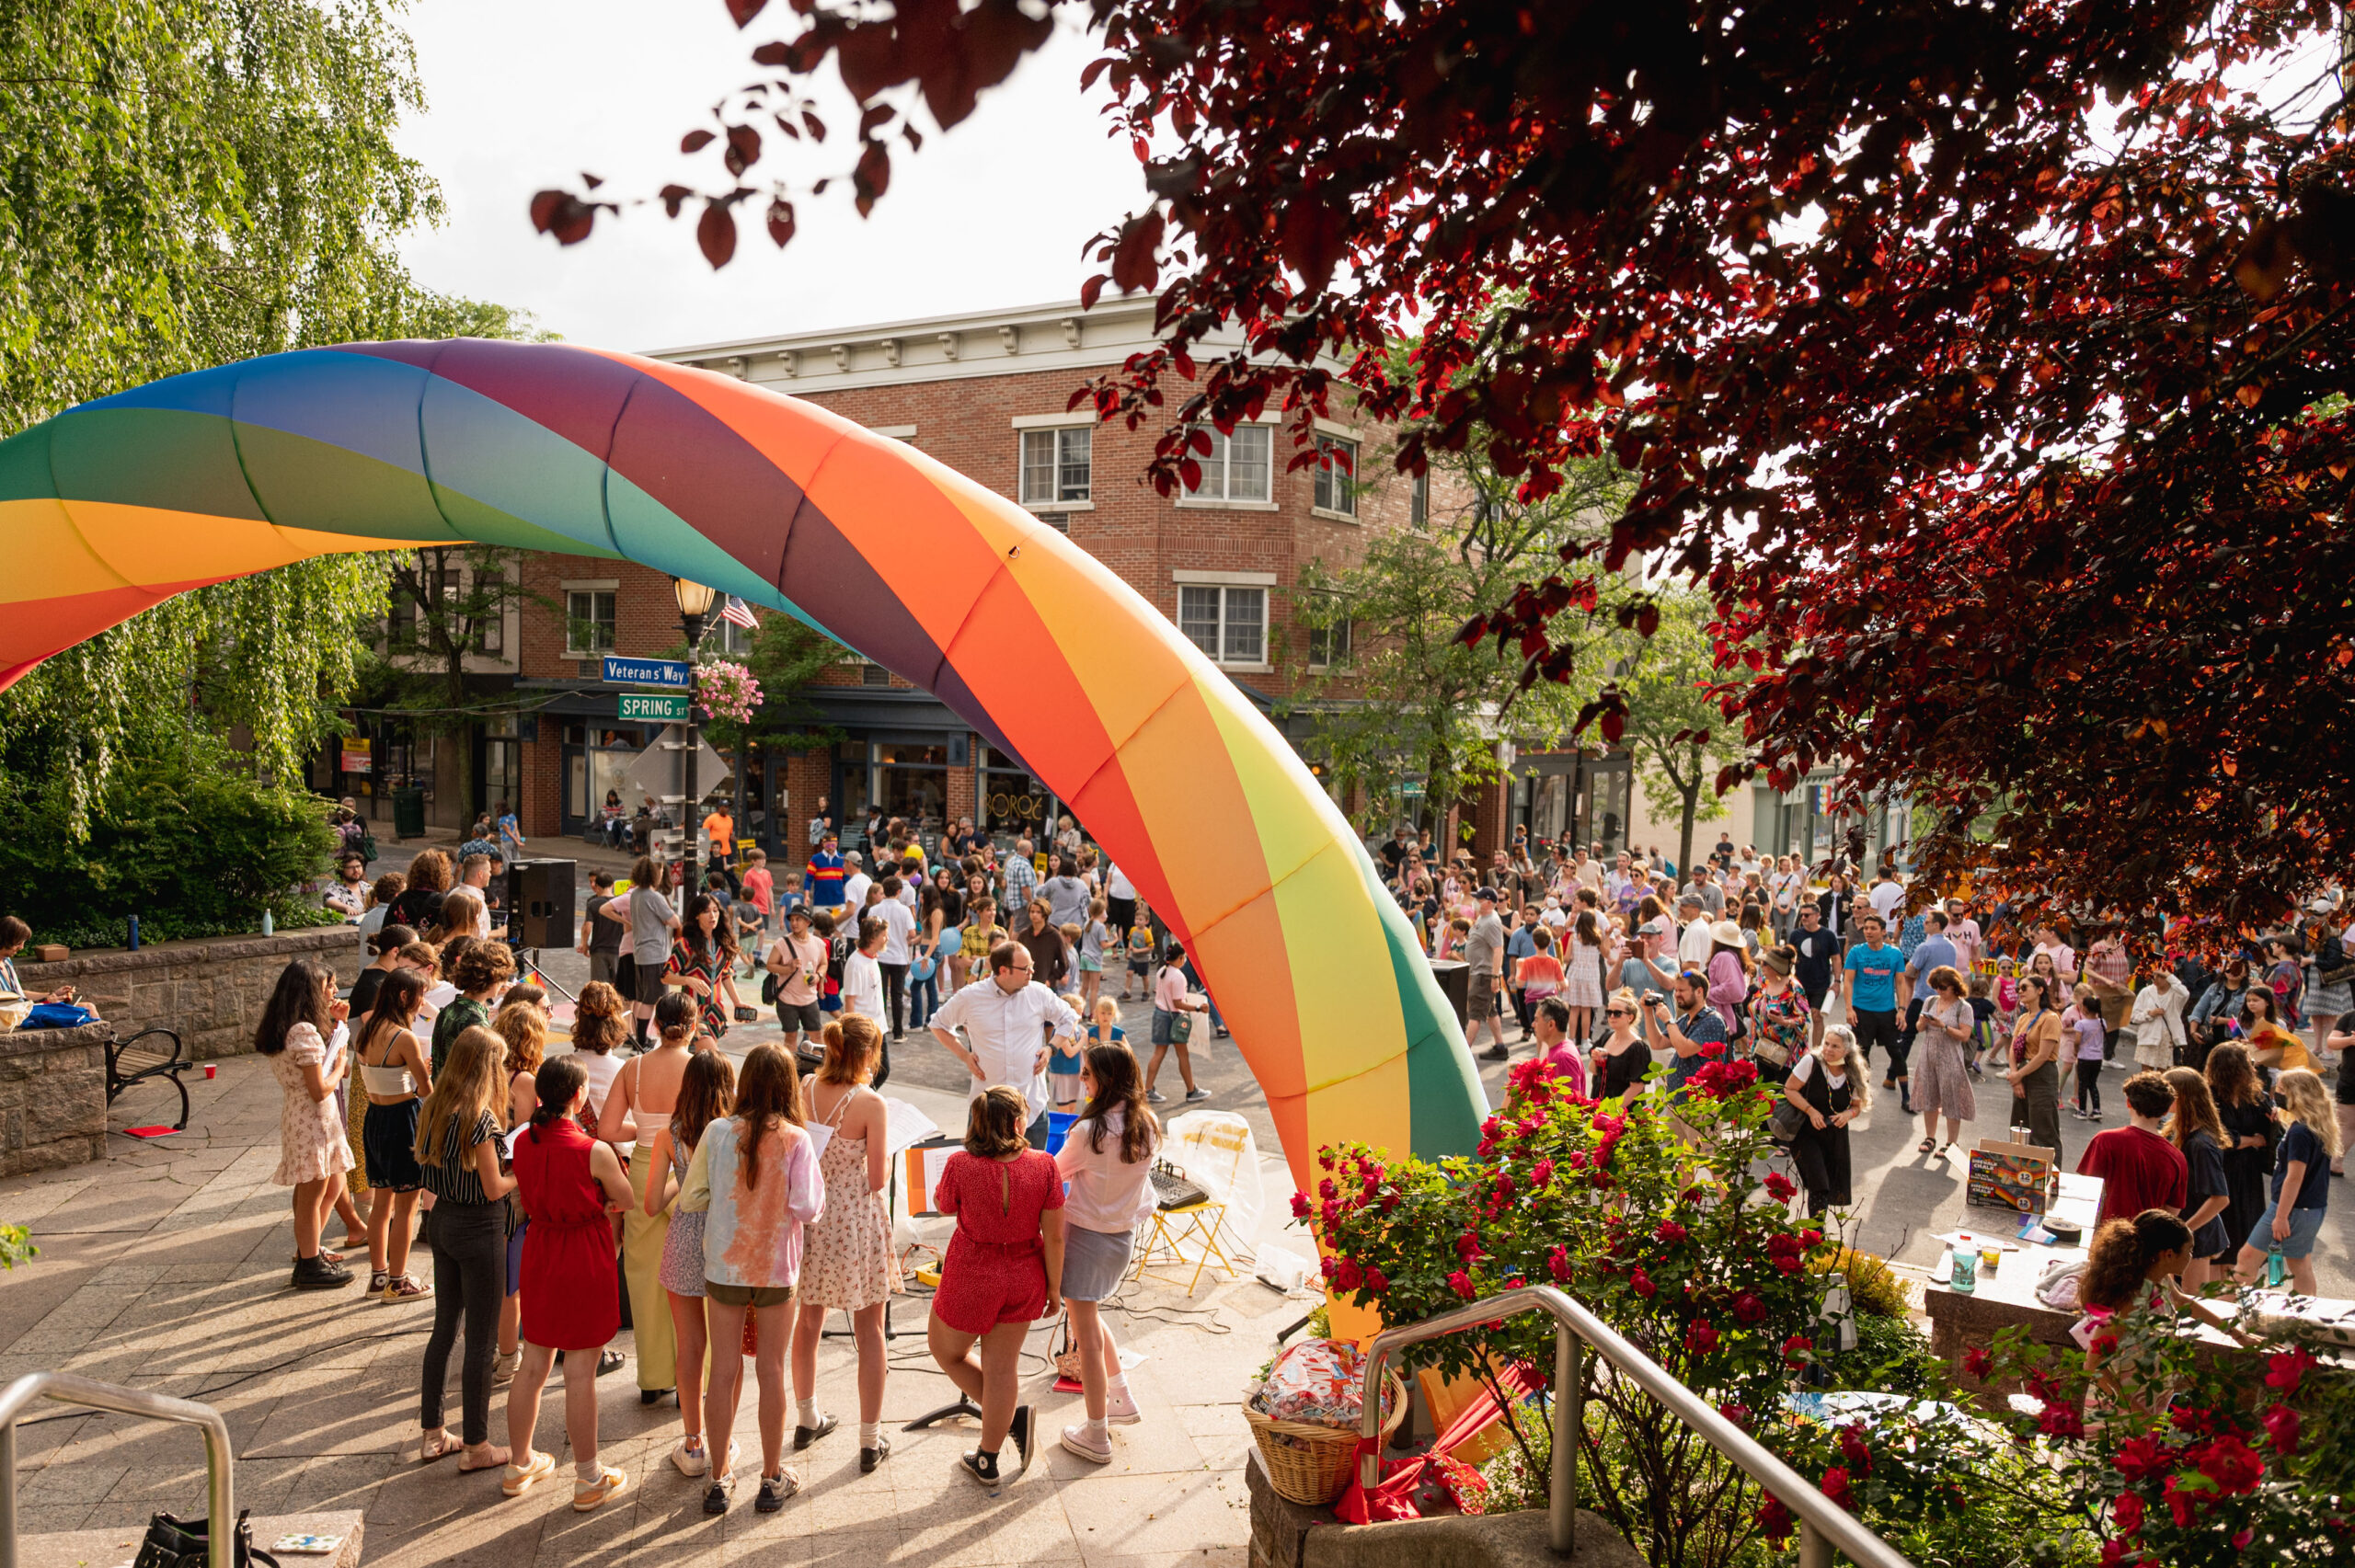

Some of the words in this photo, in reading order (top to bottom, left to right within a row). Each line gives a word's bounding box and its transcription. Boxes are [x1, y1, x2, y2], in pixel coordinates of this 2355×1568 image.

[608, 661, 662, 681] Veterans'
[663, 665, 684, 685] Way
[622, 699, 672, 716] SPRING
[676, 707, 685, 716] ST
[2020, 1173, 2030, 1181] 12
